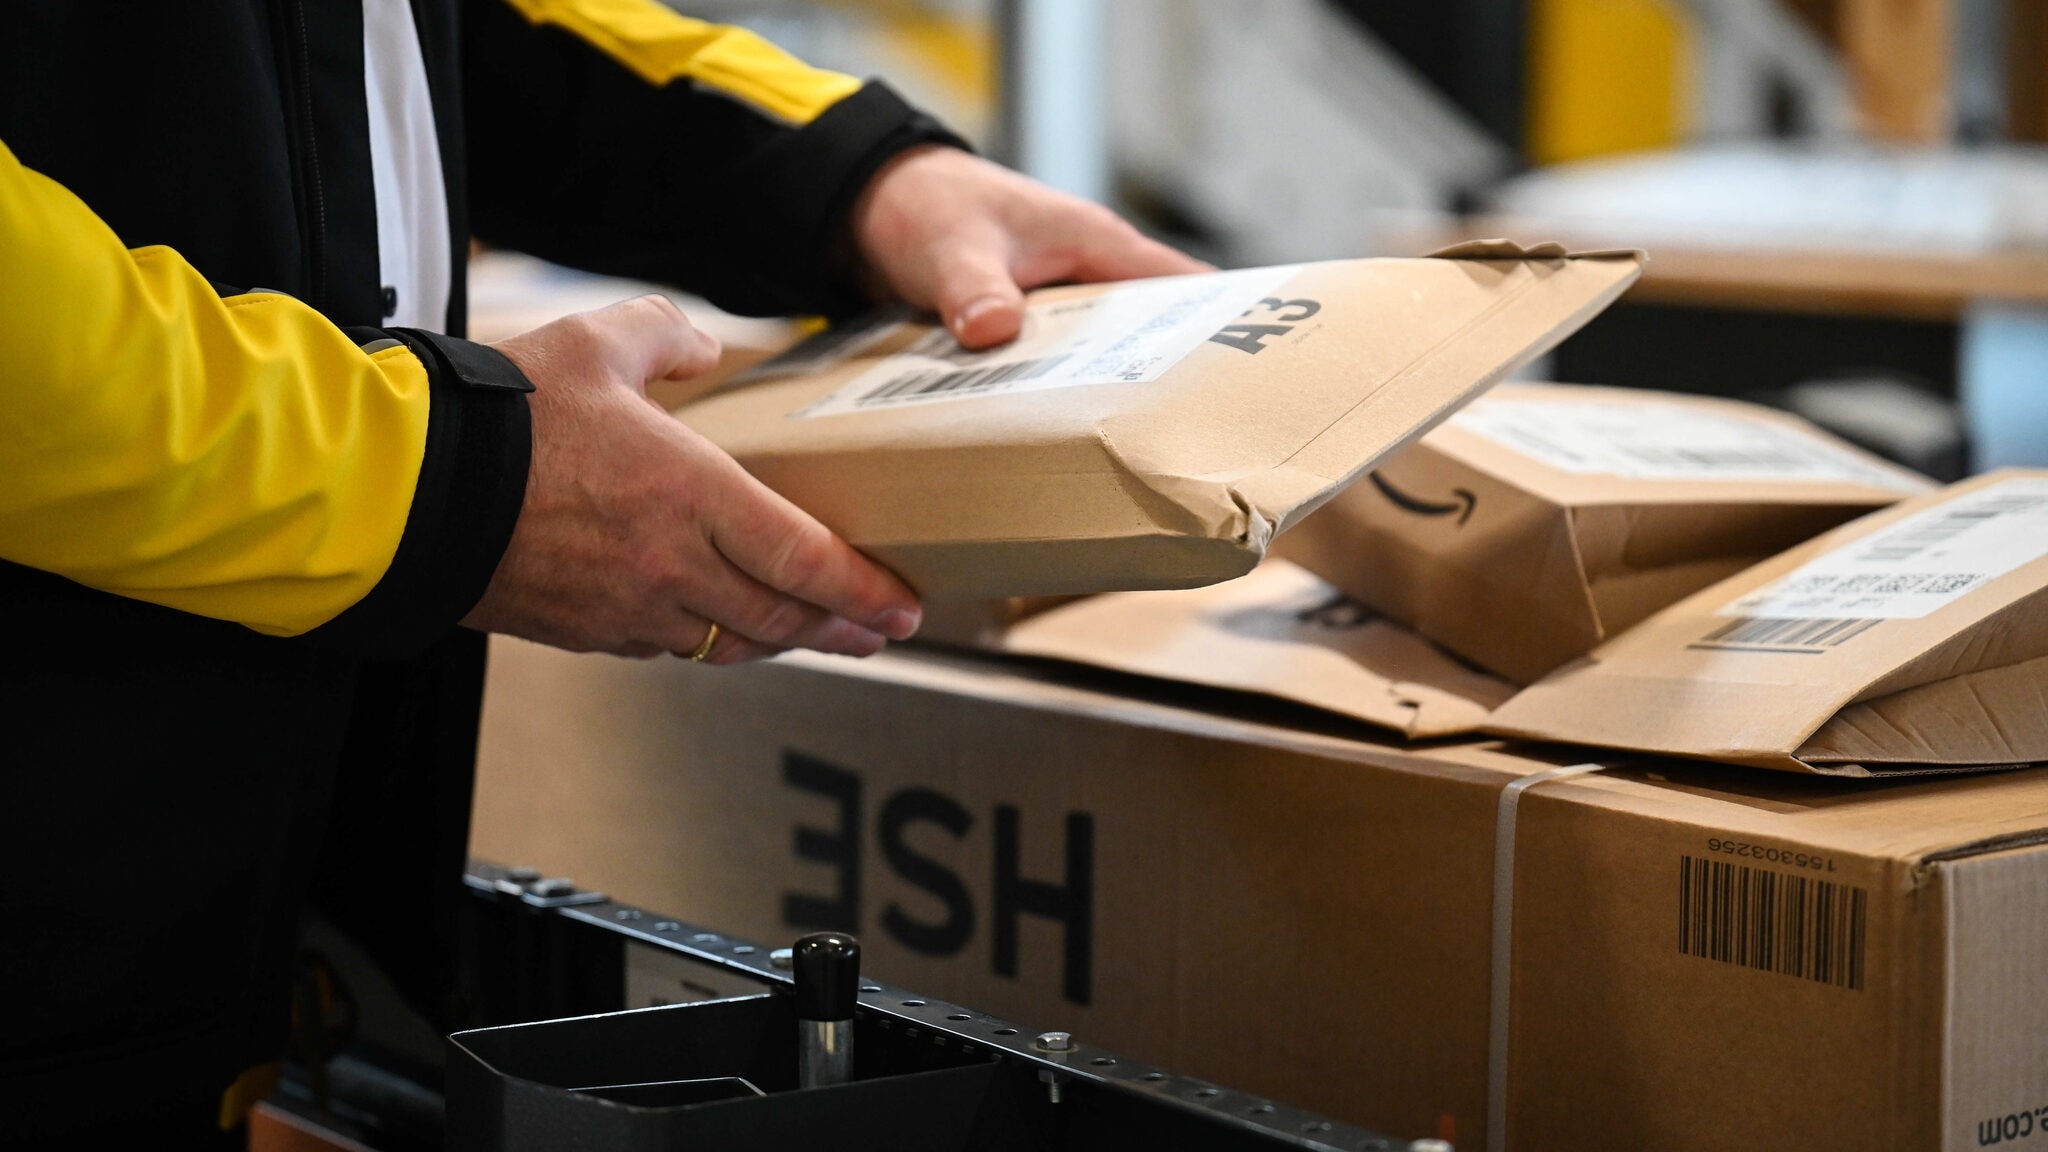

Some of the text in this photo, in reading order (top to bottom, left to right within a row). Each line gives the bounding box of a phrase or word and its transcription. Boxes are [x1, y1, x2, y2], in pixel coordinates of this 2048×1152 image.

[1209, 297, 1320, 355] A3
[783, 751, 1093, 1006] HSE
[1709, 838, 1837, 872] 155303256
